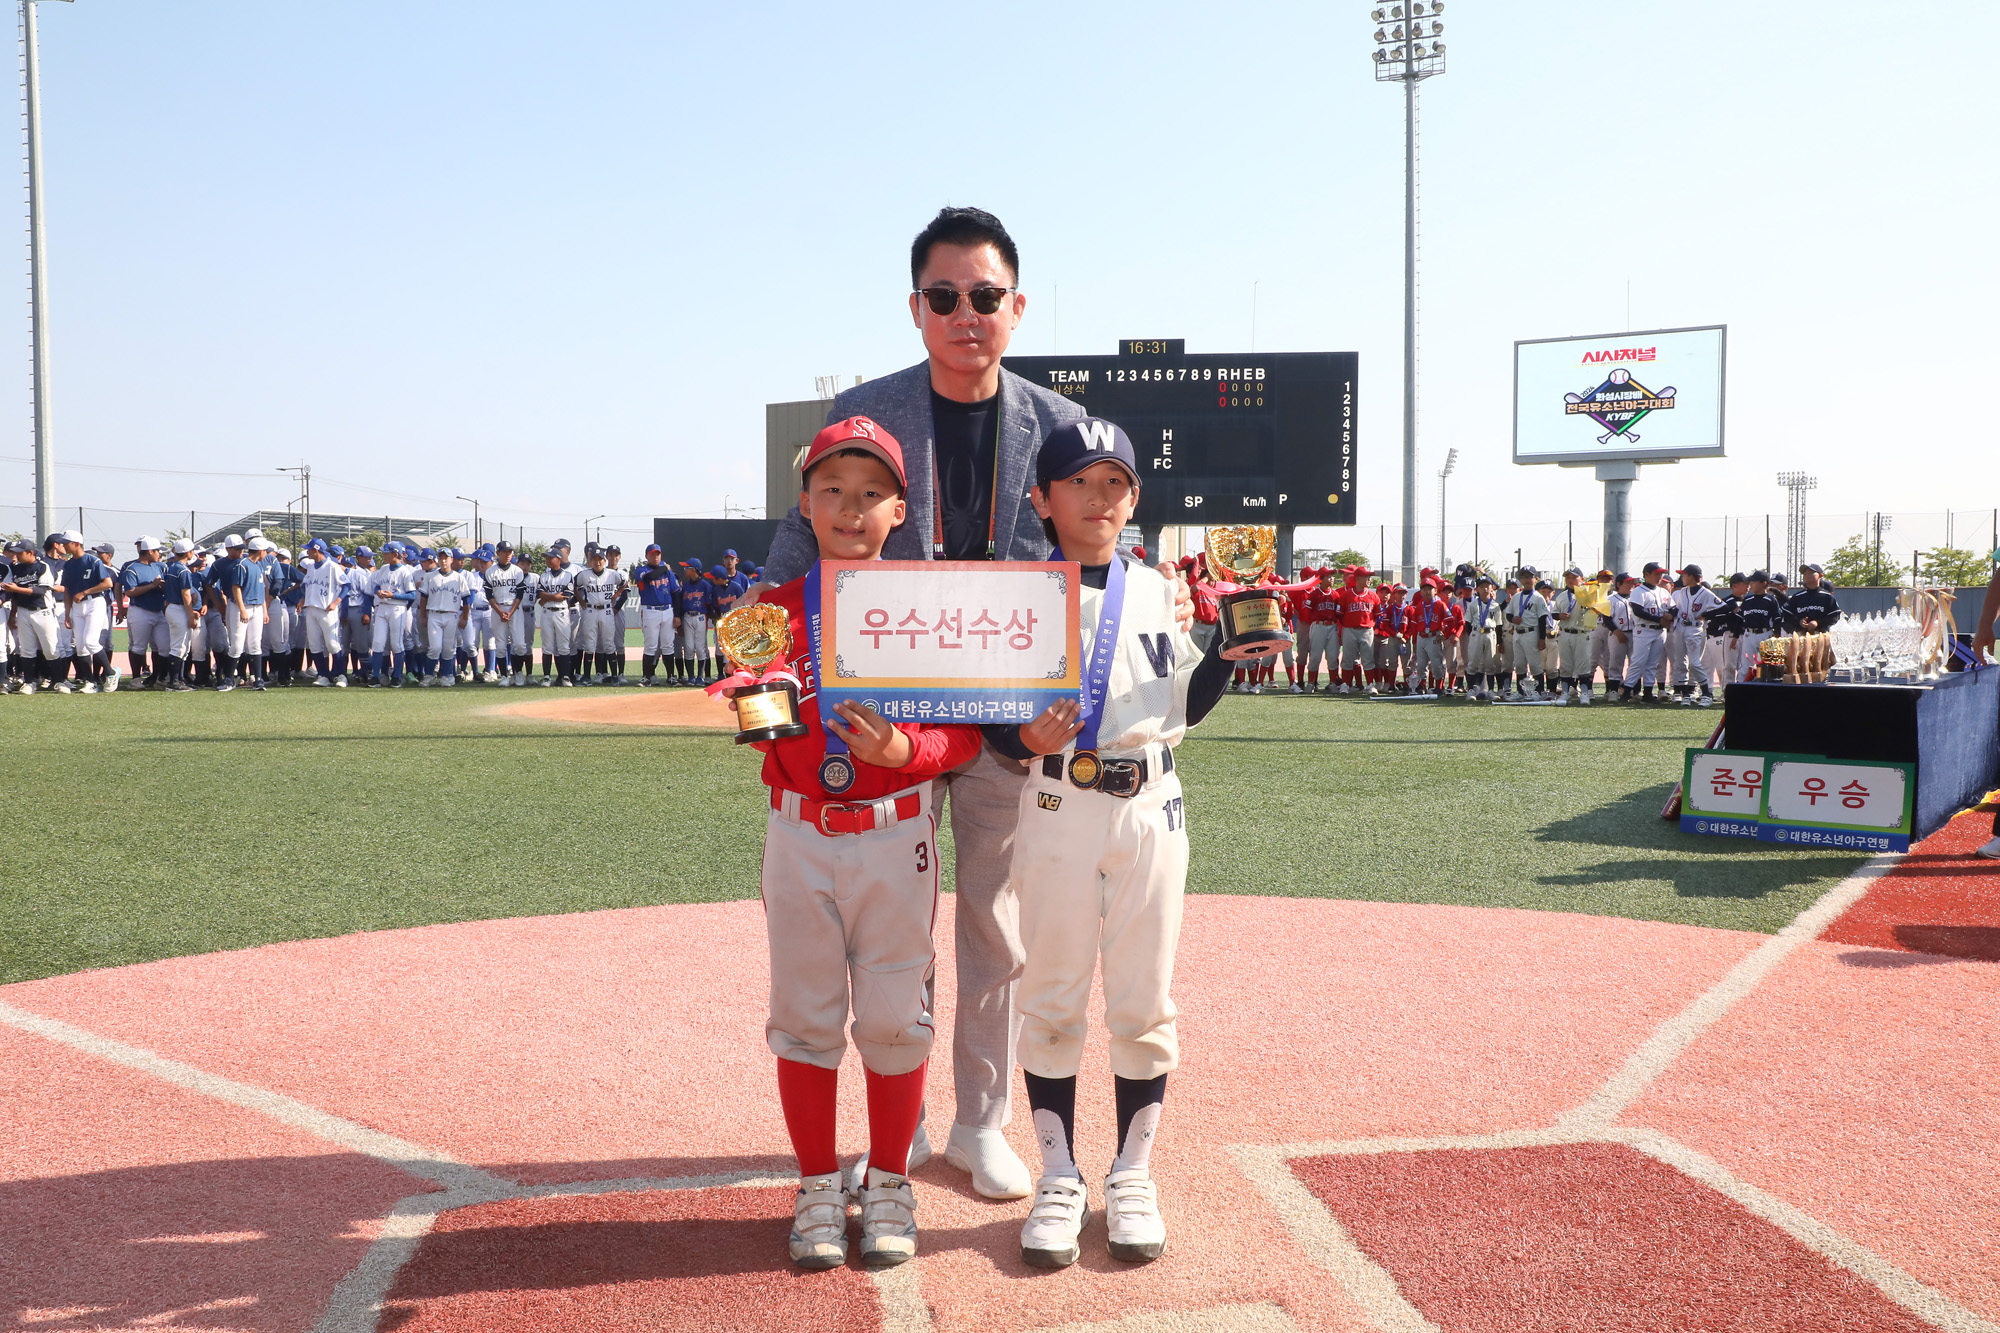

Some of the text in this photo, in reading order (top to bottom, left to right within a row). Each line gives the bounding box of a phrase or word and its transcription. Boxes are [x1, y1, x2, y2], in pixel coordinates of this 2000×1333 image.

[1128, 341, 1167, 354] 16:31
[1582, 347, 1656, 363] 시사저널
[1049, 370, 1090, 382] TEAM
[1052, 384, 1085, 395] 시상식
[1344, 381, 1350, 392] 1
[1580, 385, 1595, 398] 2024
[1343, 394, 1351, 404] 2
[1595, 390, 1643, 402] 화성시장배
[1343, 406, 1350, 417] 3
[1566, 398, 1674, 413] 전국유소년야구대회
[1605, 412, 1636, 421] KYBF
[853, 417, 876, 440] S
[1342, 419, 1350, 429] 4
[1076, 420, 1115, 452] W
[1162, 429, 1173, 440] H
[1342, 431, 1350, 442] 5
[1162, 443, 1172, 455] E
[1342, 444, 1350, 454] 6
[1153, 458, 1172, 470] FC
[1342, 456, 1350, 467] 7
[1342, 469, 1350, 479] 8
[1342, 481, 1350, 492] 9
[1184, 494, 1288, 507] SP Km/h P
[83, 568, 92, 579] J
[586, 584, 613, 592] DAECHI
[859, 608, 1038, 650] 우수선수상
[1138, 632, 1176, 678] W
[884, 700, 1034, 719] 대한유소년야구연맹
[1798, 777, 1870, 809] 우승
[1162, 796, 1182, 832] 17
[1790, 831, 1889, 850] 대한유소년야구연맹
[915, 841, 928, 873] 3
